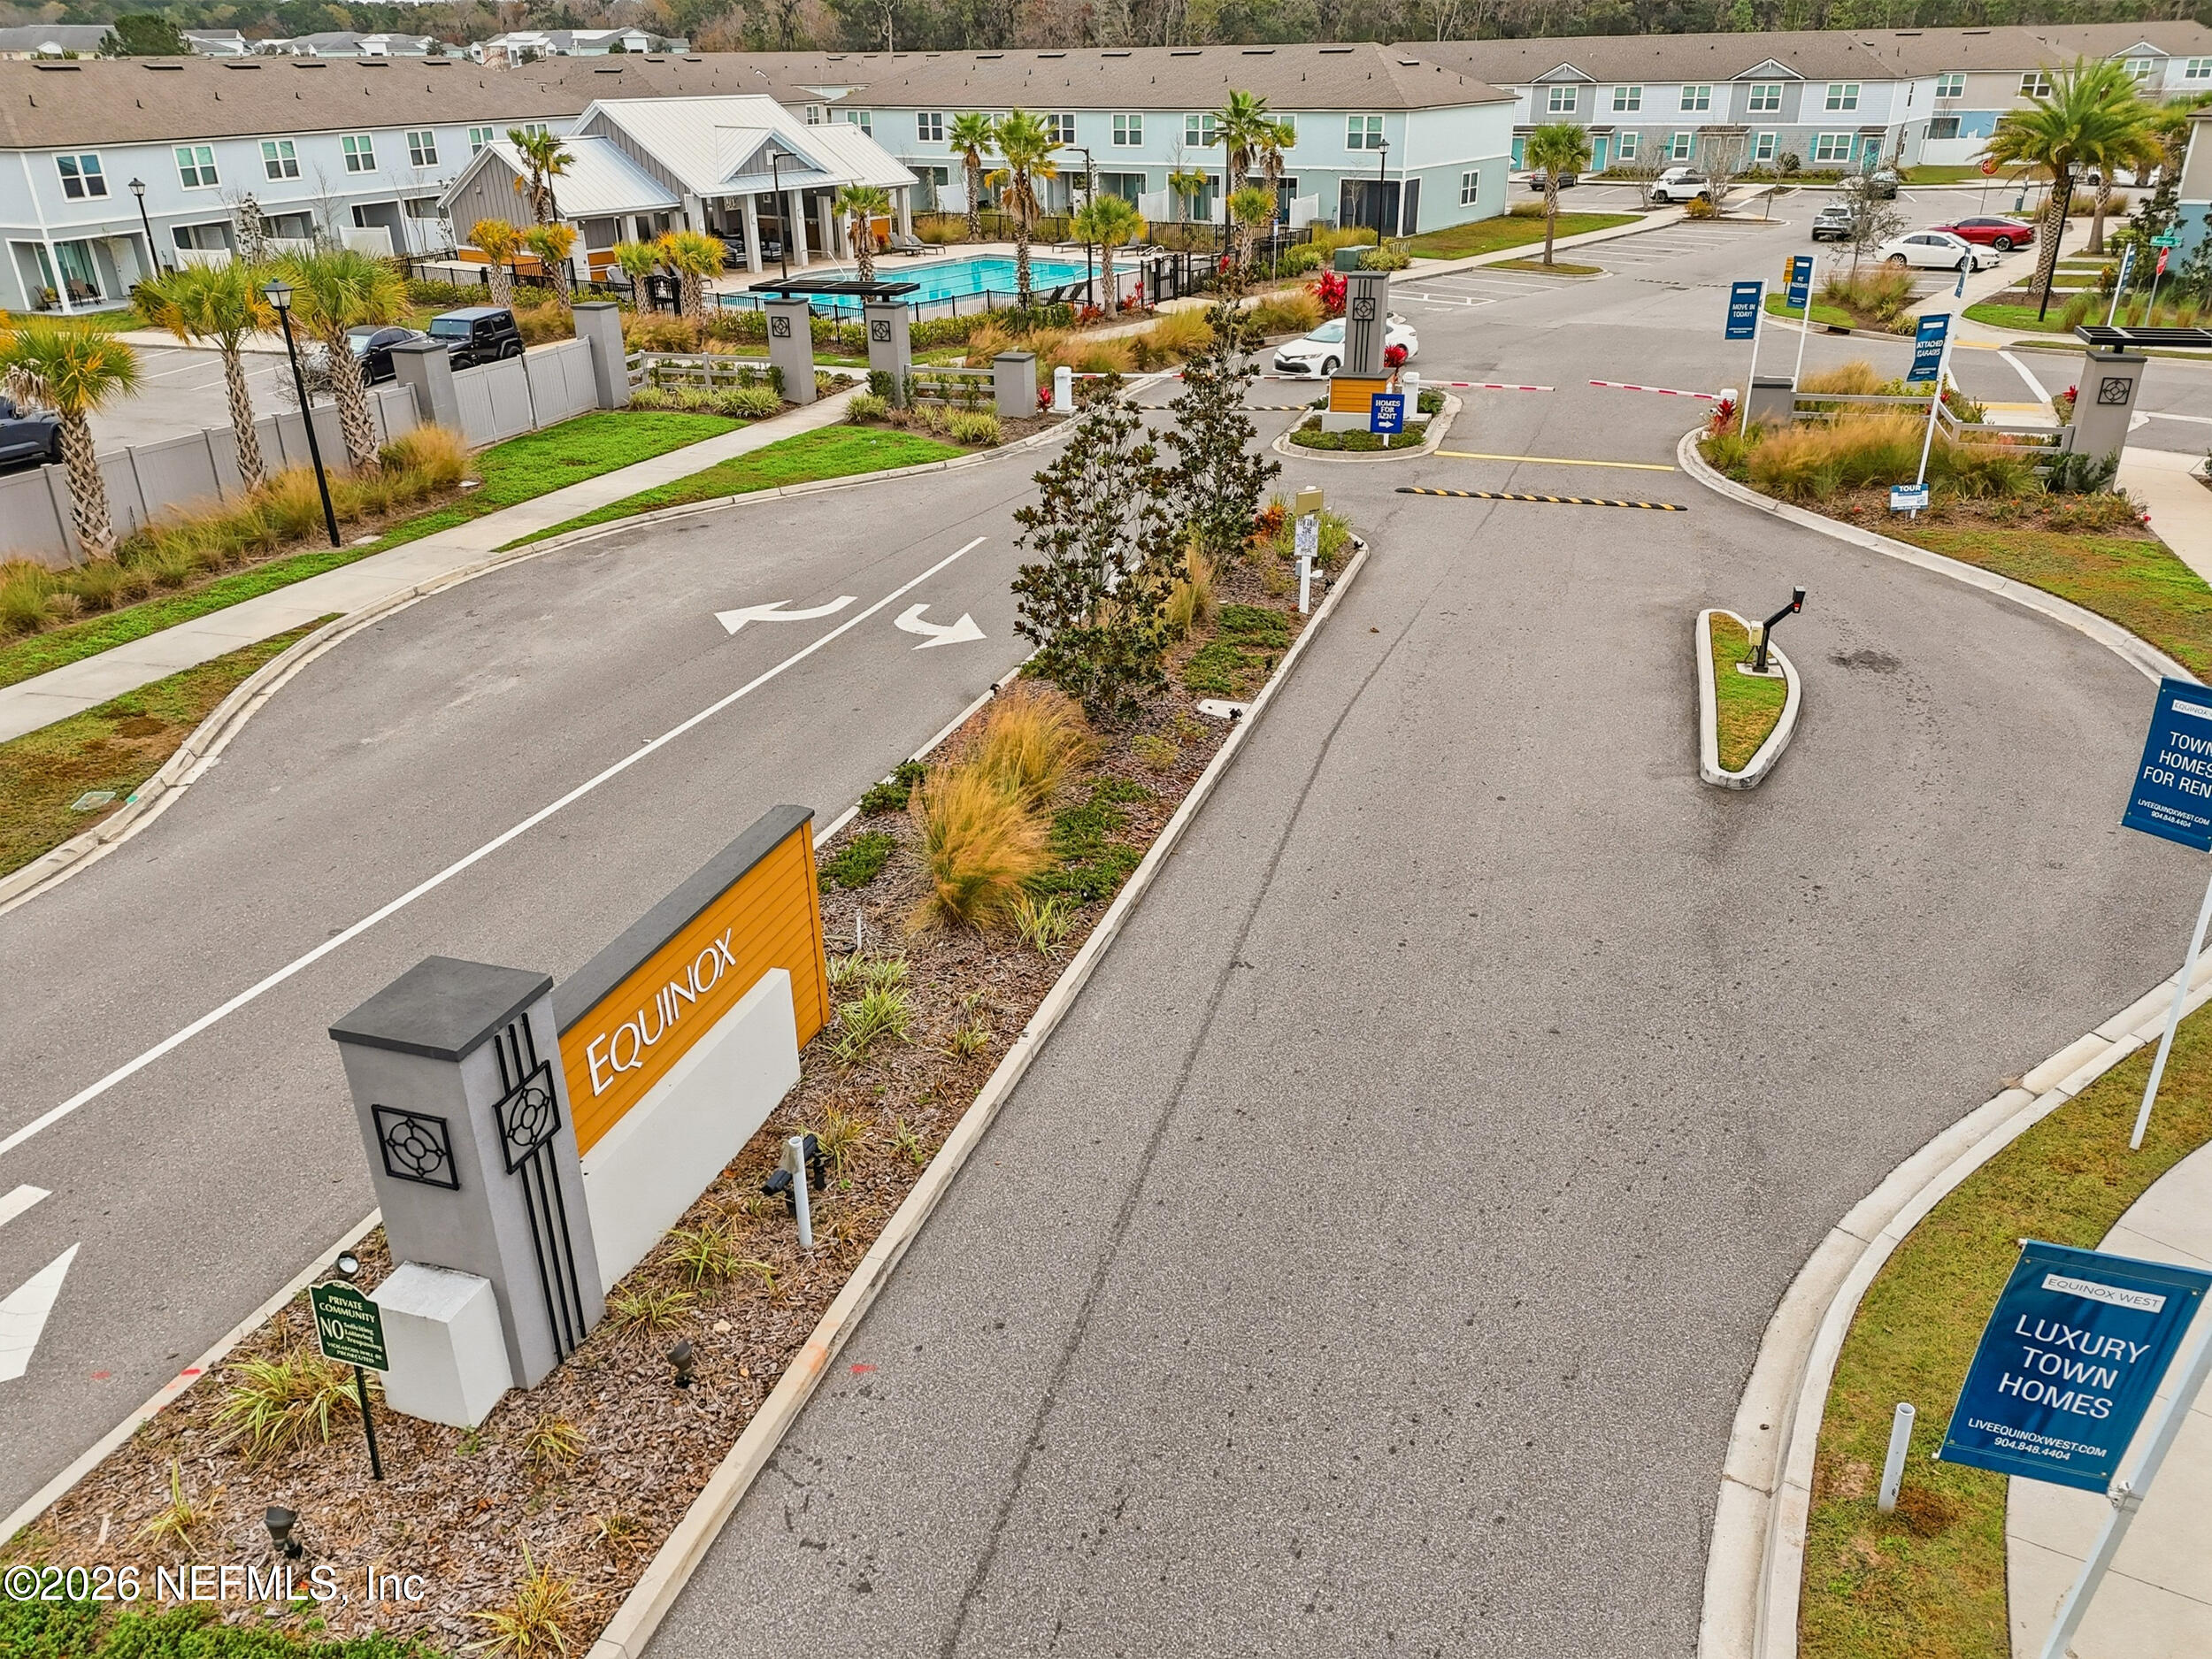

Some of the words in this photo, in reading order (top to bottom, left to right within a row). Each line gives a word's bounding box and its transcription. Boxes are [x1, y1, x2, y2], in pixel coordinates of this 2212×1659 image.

[2143, 765, 2175, 787] FOR
[2178, 776, 2212, 798] REN
[585, 927, 737, 1097] EQUINOX
[328, 1294, 364, 1311] PRIVATE
[2047, 1278, 2116, 1300] EQUINOX
[2119, 1292, 2162, 1309] WEST
[319, 1302, 376, 1324] COMMUNITY
[319, 1316, 344, 1340] NO
[2014, 1313, 2151, 1365] LUXURY
[2022, 1346, 2119, 1391] TOWN
[1997, 1372, 2114, 1420] HOMES
[1968, 1417, 2108, 1458] LIVEEQUINOXWEST.COM
[1994, 1436, 2071, 1461] 904.848.4404
